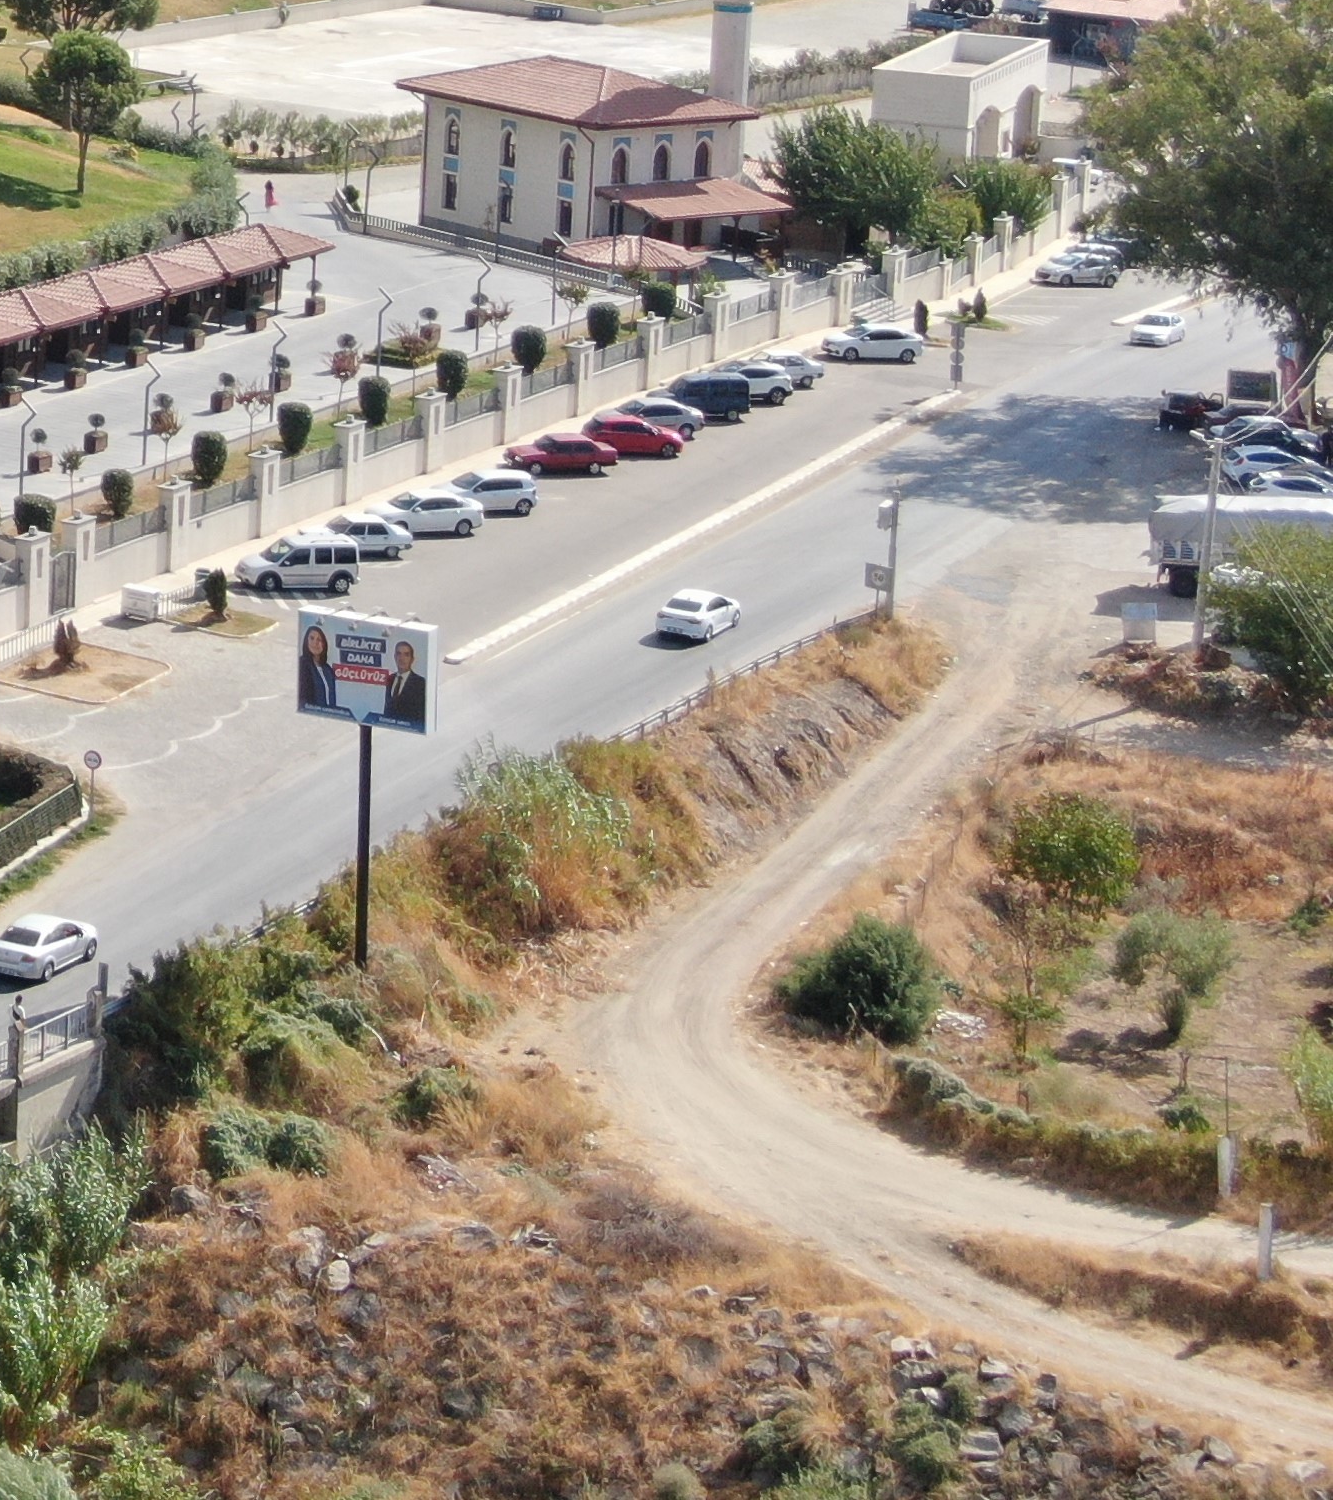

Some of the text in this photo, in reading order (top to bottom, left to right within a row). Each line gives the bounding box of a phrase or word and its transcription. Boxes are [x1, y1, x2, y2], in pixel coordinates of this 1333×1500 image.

[341, 637, 382, 651] BİRLİKTE
[347, 653, 375, 665] DAHA
[335, 667, 386, 682] GÜÇLÜYÜZ
